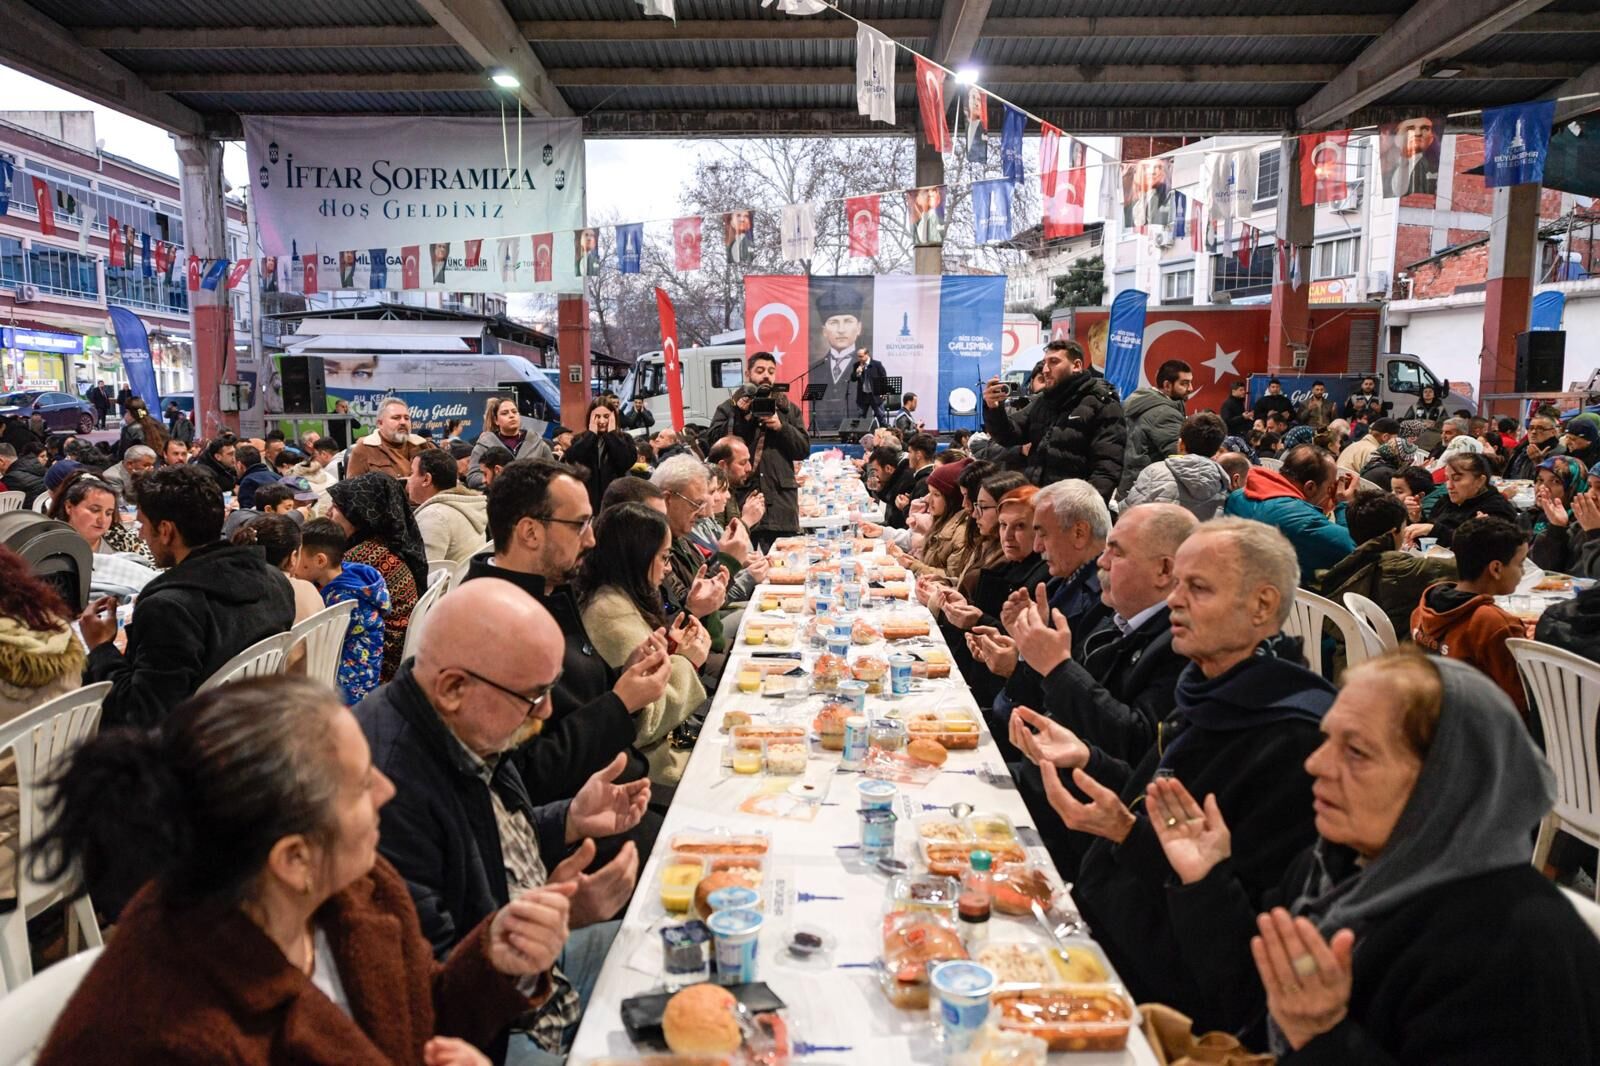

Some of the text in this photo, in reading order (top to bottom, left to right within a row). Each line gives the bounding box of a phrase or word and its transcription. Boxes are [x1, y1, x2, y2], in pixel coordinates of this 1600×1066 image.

[285, 153, 536, 196] İFTAR SOFRAMIZA
[383, 199, 504, 220] GELDİNİZ
[323, 255, 337, 265] Dr.
[407, 404, 468, 420] Hoş Geldin
